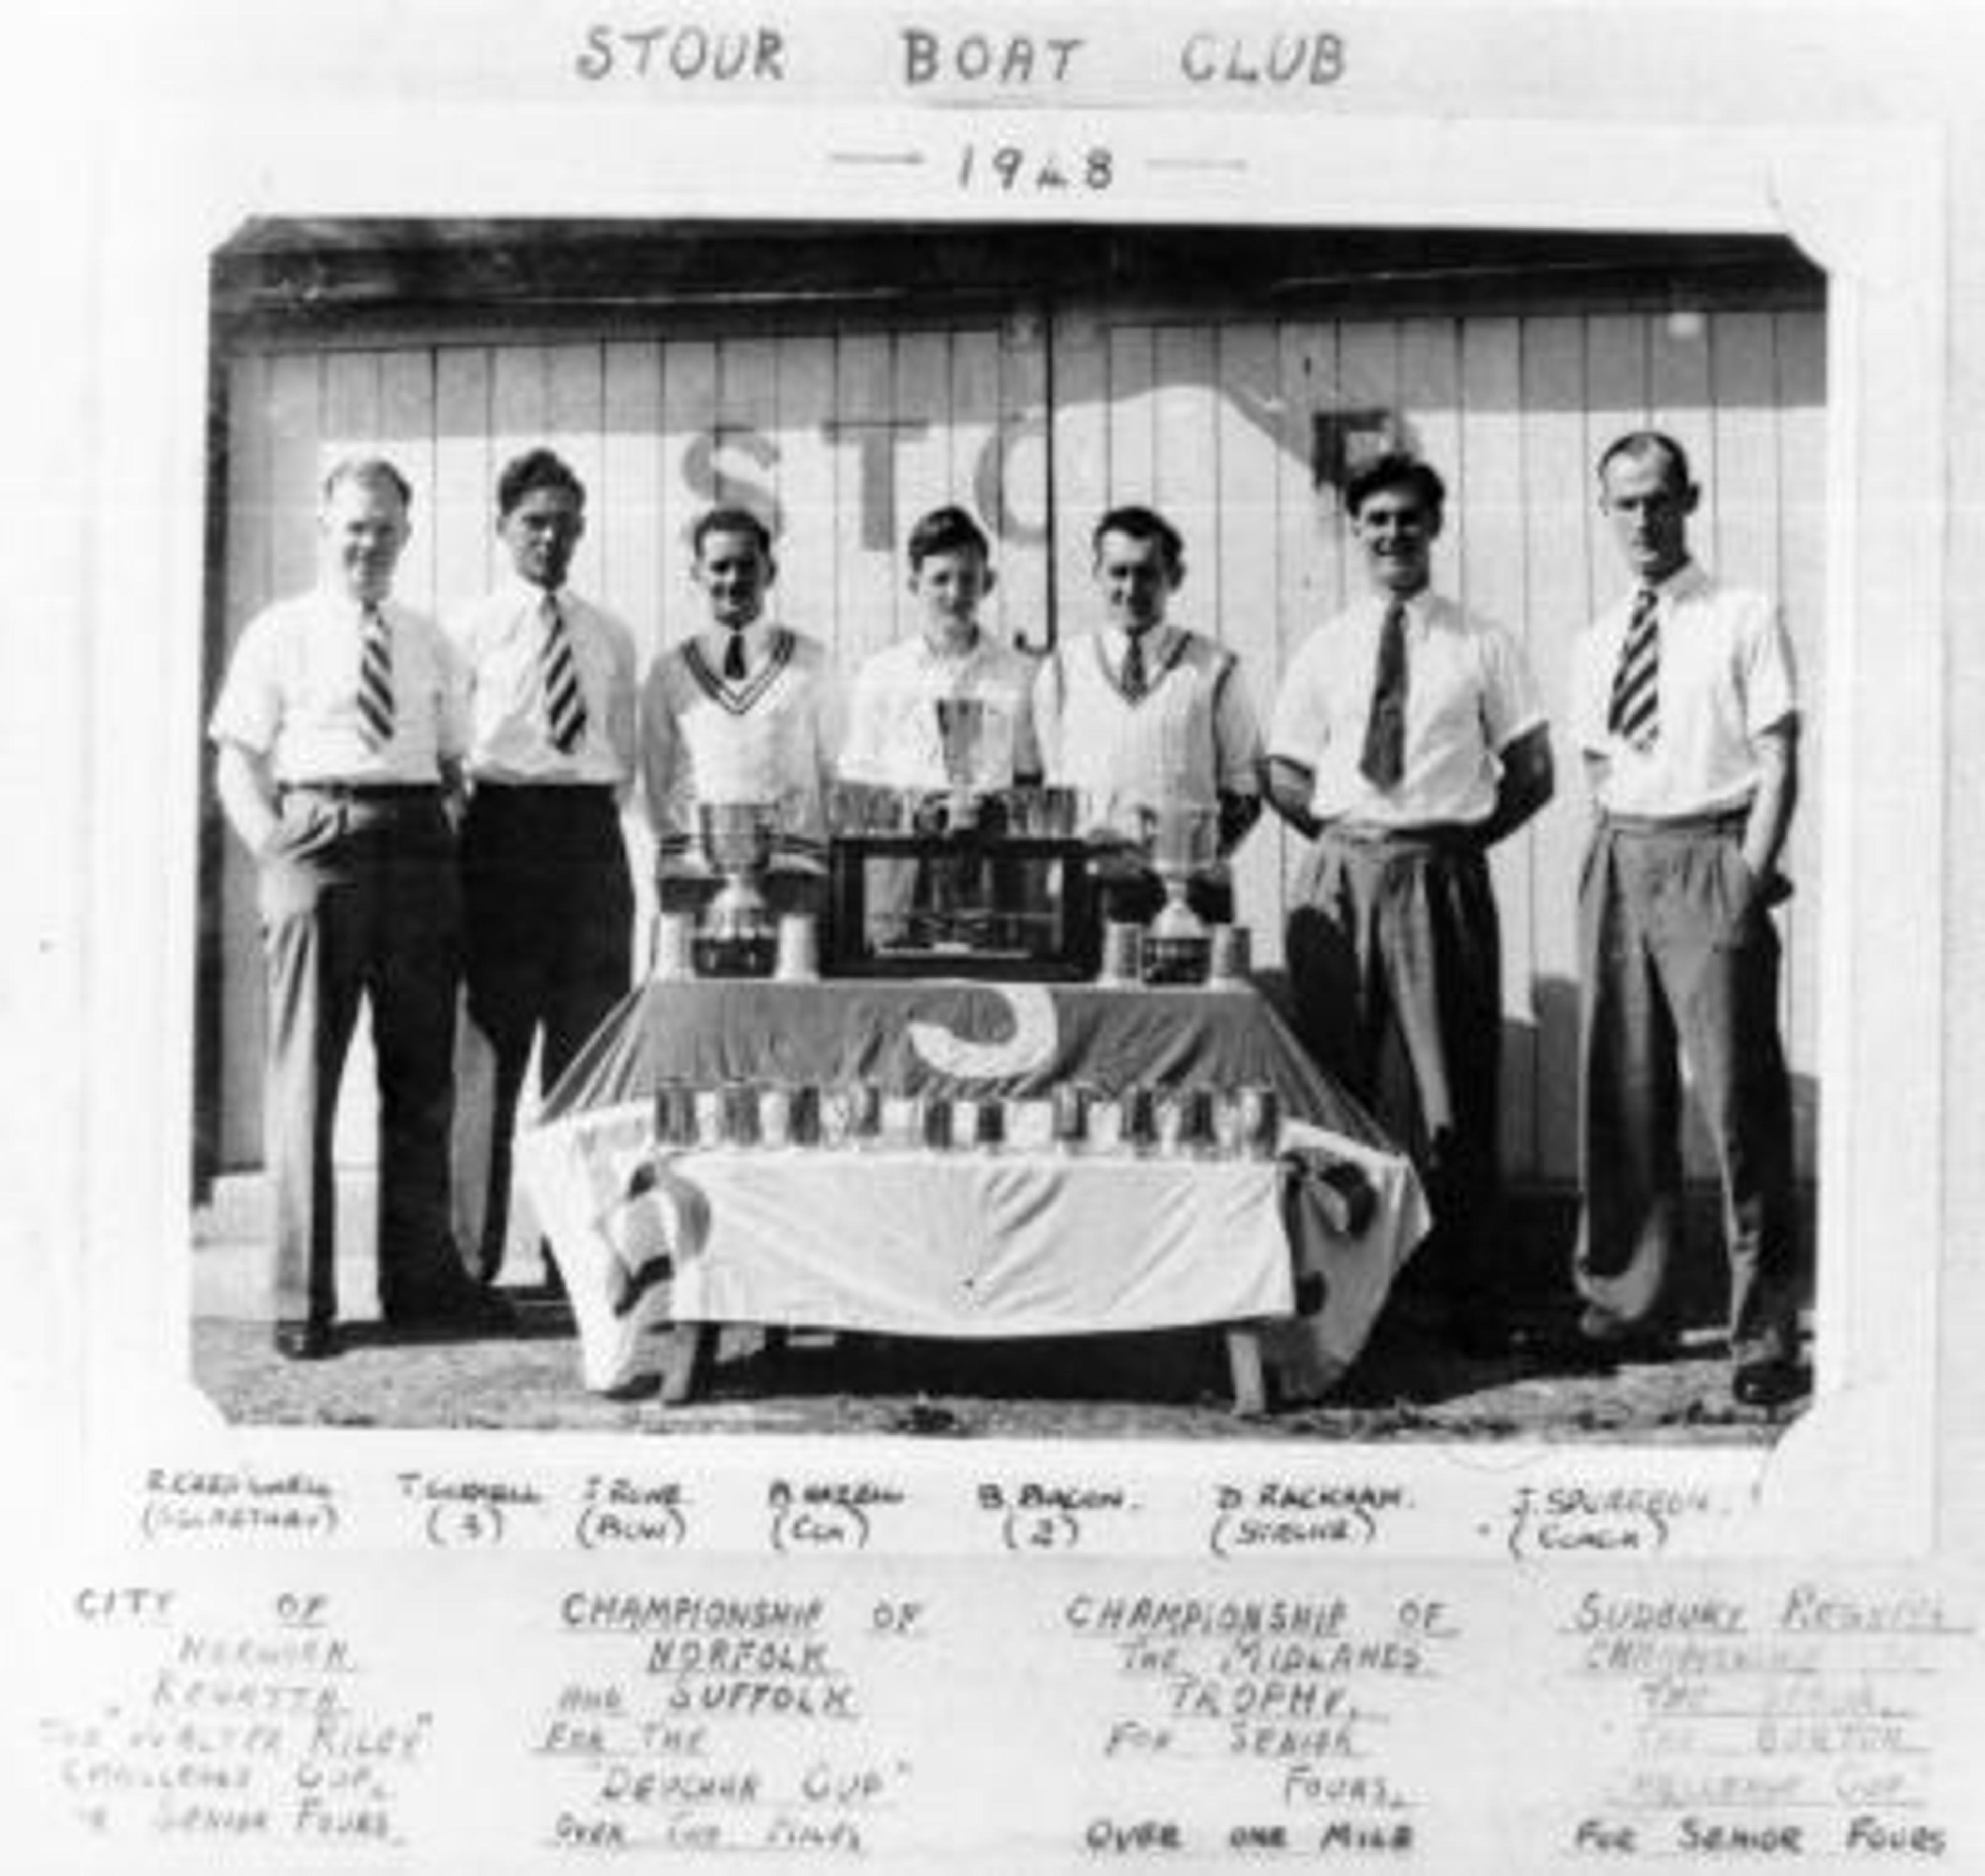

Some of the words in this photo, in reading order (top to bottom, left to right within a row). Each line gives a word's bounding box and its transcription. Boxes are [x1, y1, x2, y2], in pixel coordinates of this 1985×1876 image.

[575, 25, 787, 82] STOUR
[902, 28, 1084, 85] BOAT
[1181, 31, 1348, 87] CLUB
[958, 145, 1115, 192] 1948
[74, 1587, 176, 1620] CITY
[561, 1592, 826, 1631] CHAMPIONSHIP
[872, 1601, 924, 1633] OF
[1065, 1595, 1348, 1634] CHAMPIONSHIP
[1399, 1600, 1448, 1632] OF
[1577, 1589, 1745, 1632] SUDBURY
[648, 1638, 830, 1674] NORFOLK
[1220, 1637, 1423, 1673] MIDLANDS
[668, 1681, 853, 1715] SUFFOLK
[1230, 1722, 1352, 1757] SENIOR
[1086, 1820, 1182, 1852] OVER
[1320, 1822, 1413, 1851] MILE
[1678, 1816, 1804, 1854] SENIOR
[1845, 1814, 1946, 1857] FOURS
